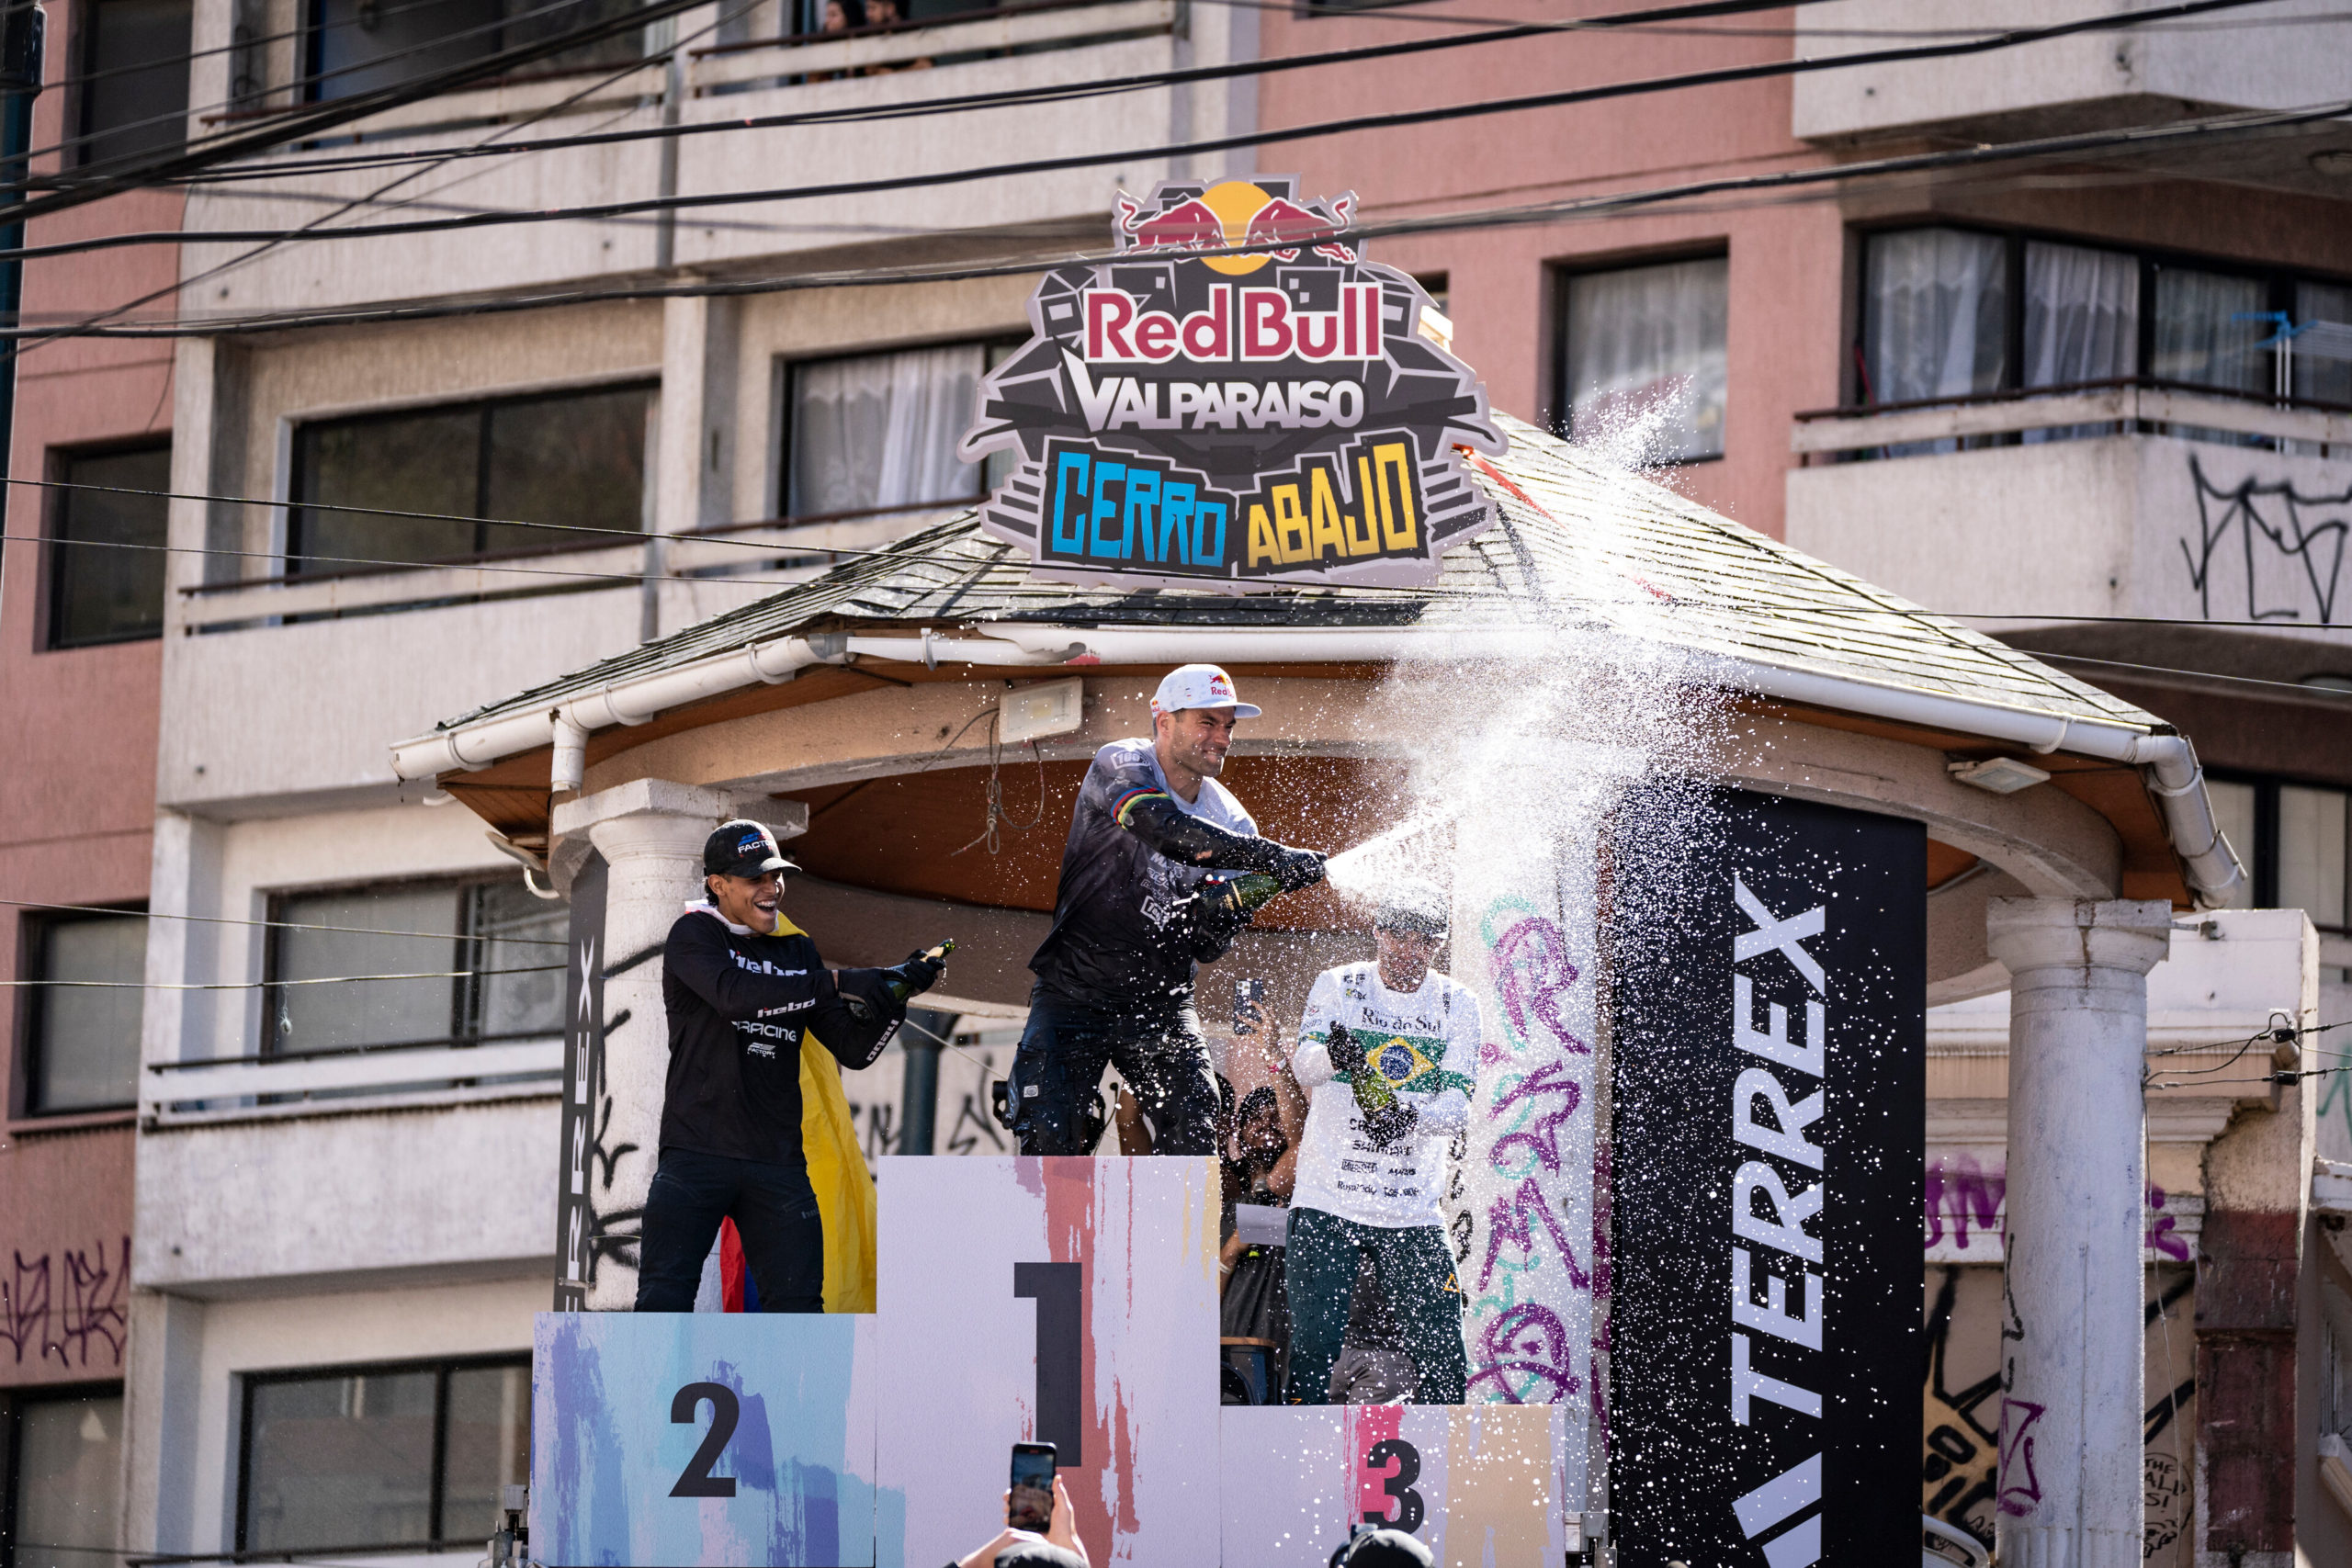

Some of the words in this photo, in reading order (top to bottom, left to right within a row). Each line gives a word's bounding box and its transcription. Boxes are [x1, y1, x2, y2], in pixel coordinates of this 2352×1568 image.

[1083, 283, 1232, 363] Red
[1239, 282, 1383, 362] Bull
[1062, 347, 1364, 433] VALPARAISO
[1051, 450, 1227, 568] CERRO
[1247, 442, 1419, 569] ABAJO
[1210, 686, 1227, 696] Red
[566, 935, 594, 1312] RREX
[1732, 874, 1826, 1427] TERREX
[1014, 1262, 1082, 1467] 1
[668, 1382, 740, 1497] 2
[1363, 1439, 1424, 1535] 3
